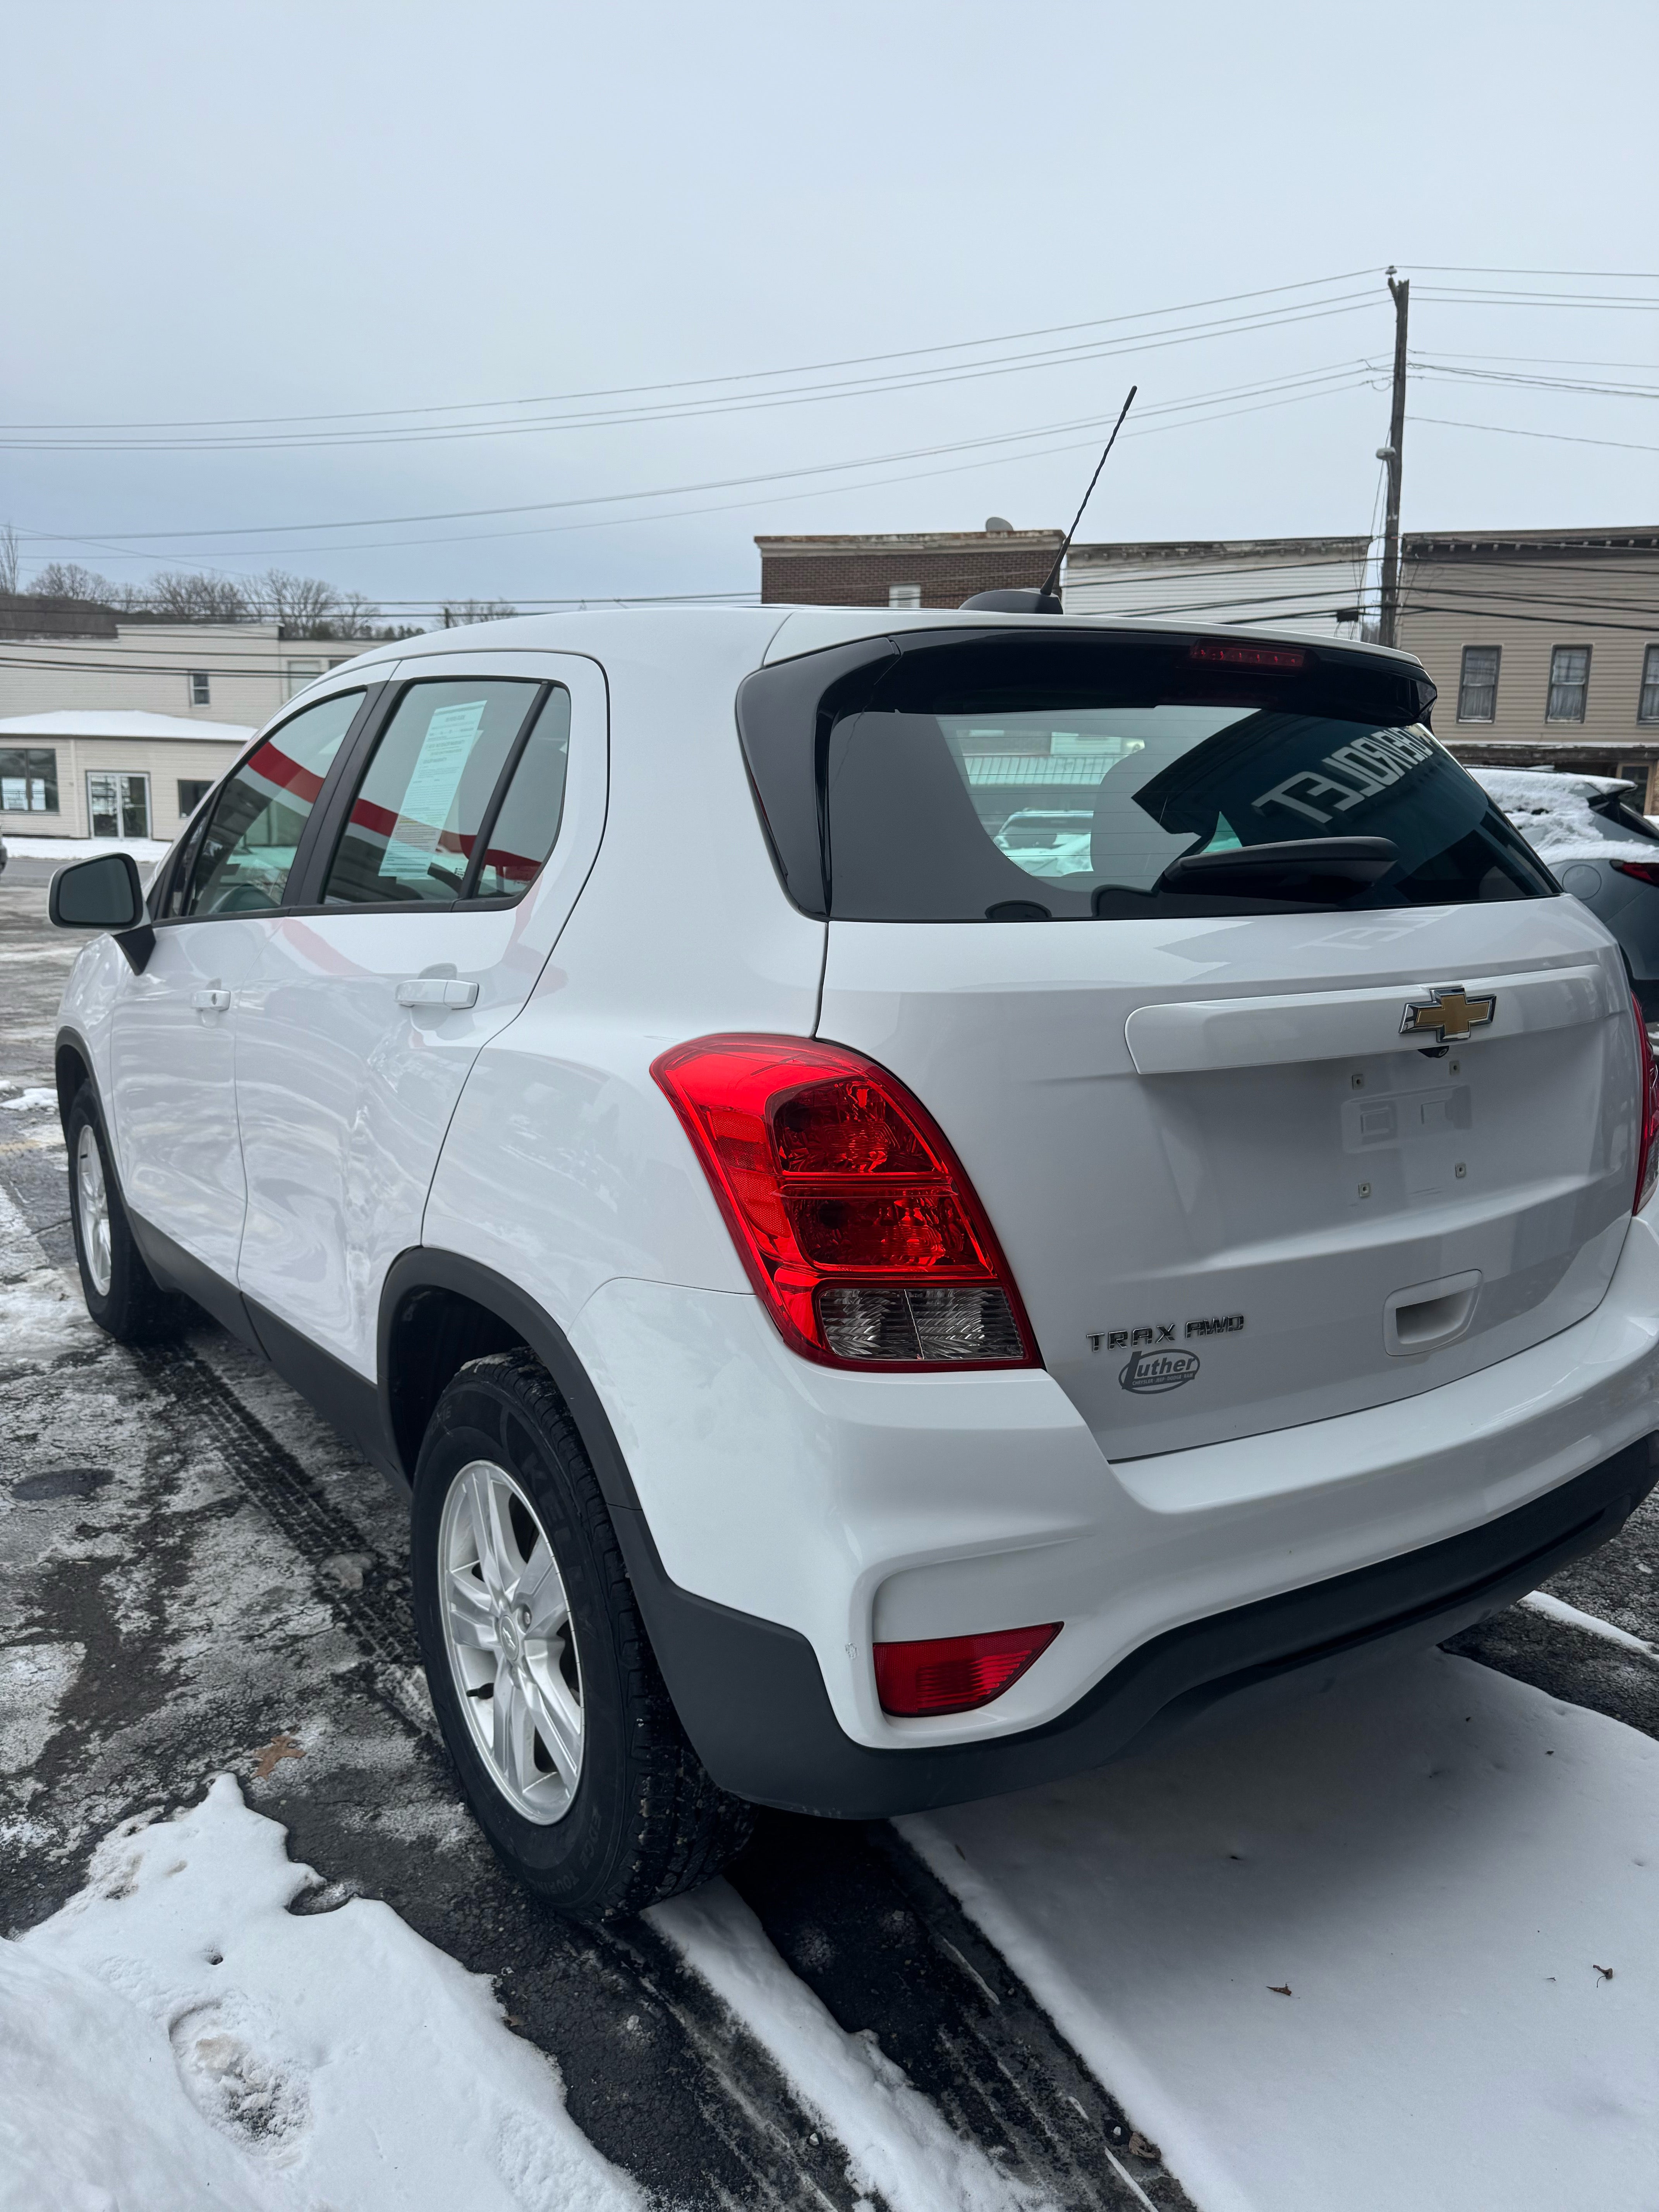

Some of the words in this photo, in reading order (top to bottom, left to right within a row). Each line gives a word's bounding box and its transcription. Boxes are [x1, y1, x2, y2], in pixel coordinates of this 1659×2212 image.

[1086, 1324, 1175, 1352] TRAX
[1185, 1315, 1244, 1338] AWD
[1122, 1351, 1196, 1389] Luther
[521, 1451, 598, 1639] KELLY
[579, 1804, 603, 1870] EDGE
